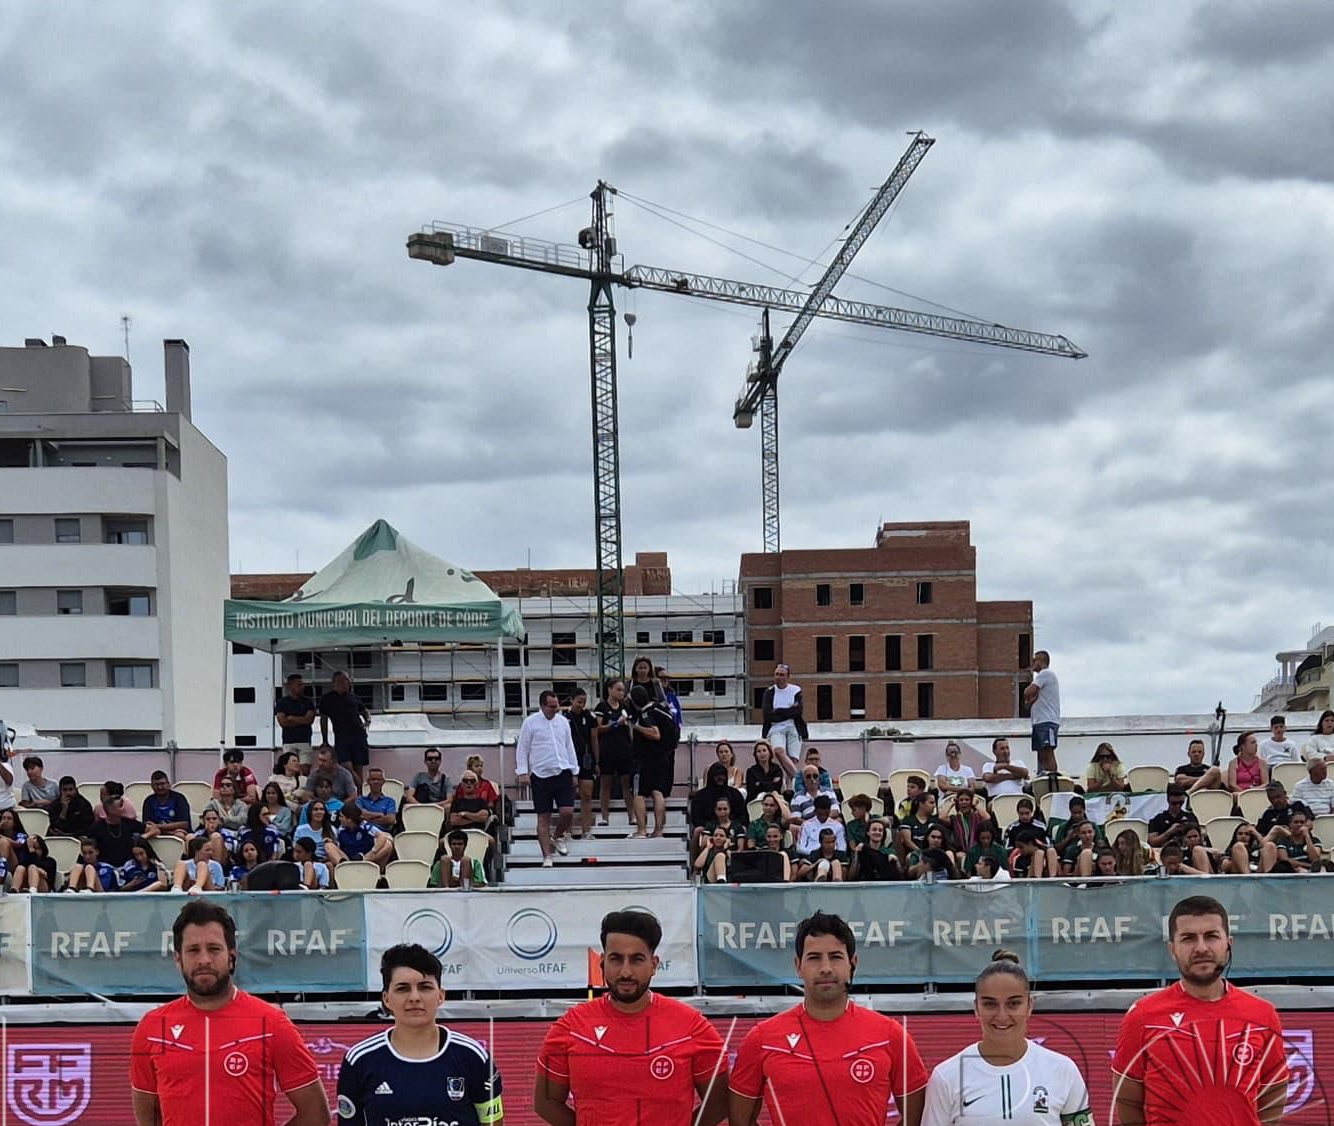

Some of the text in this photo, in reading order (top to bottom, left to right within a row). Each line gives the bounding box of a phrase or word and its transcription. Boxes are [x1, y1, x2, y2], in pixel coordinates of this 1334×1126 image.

[236, 612, 294, 630] INSTITUTO
[297, 610, 359, 629] MUNICIPAL
[362, 610, 382, 627] DEL
[386, 610, 436, 627] DEPORTE
[439, 610, 453, 626] DE
[51, 930, 132, 958] RFAF
[267, 928, 348, 956] RFAF
[934, 918, 1011, 946] RFAF
[1052, 916, 1132, 944] RFAF
